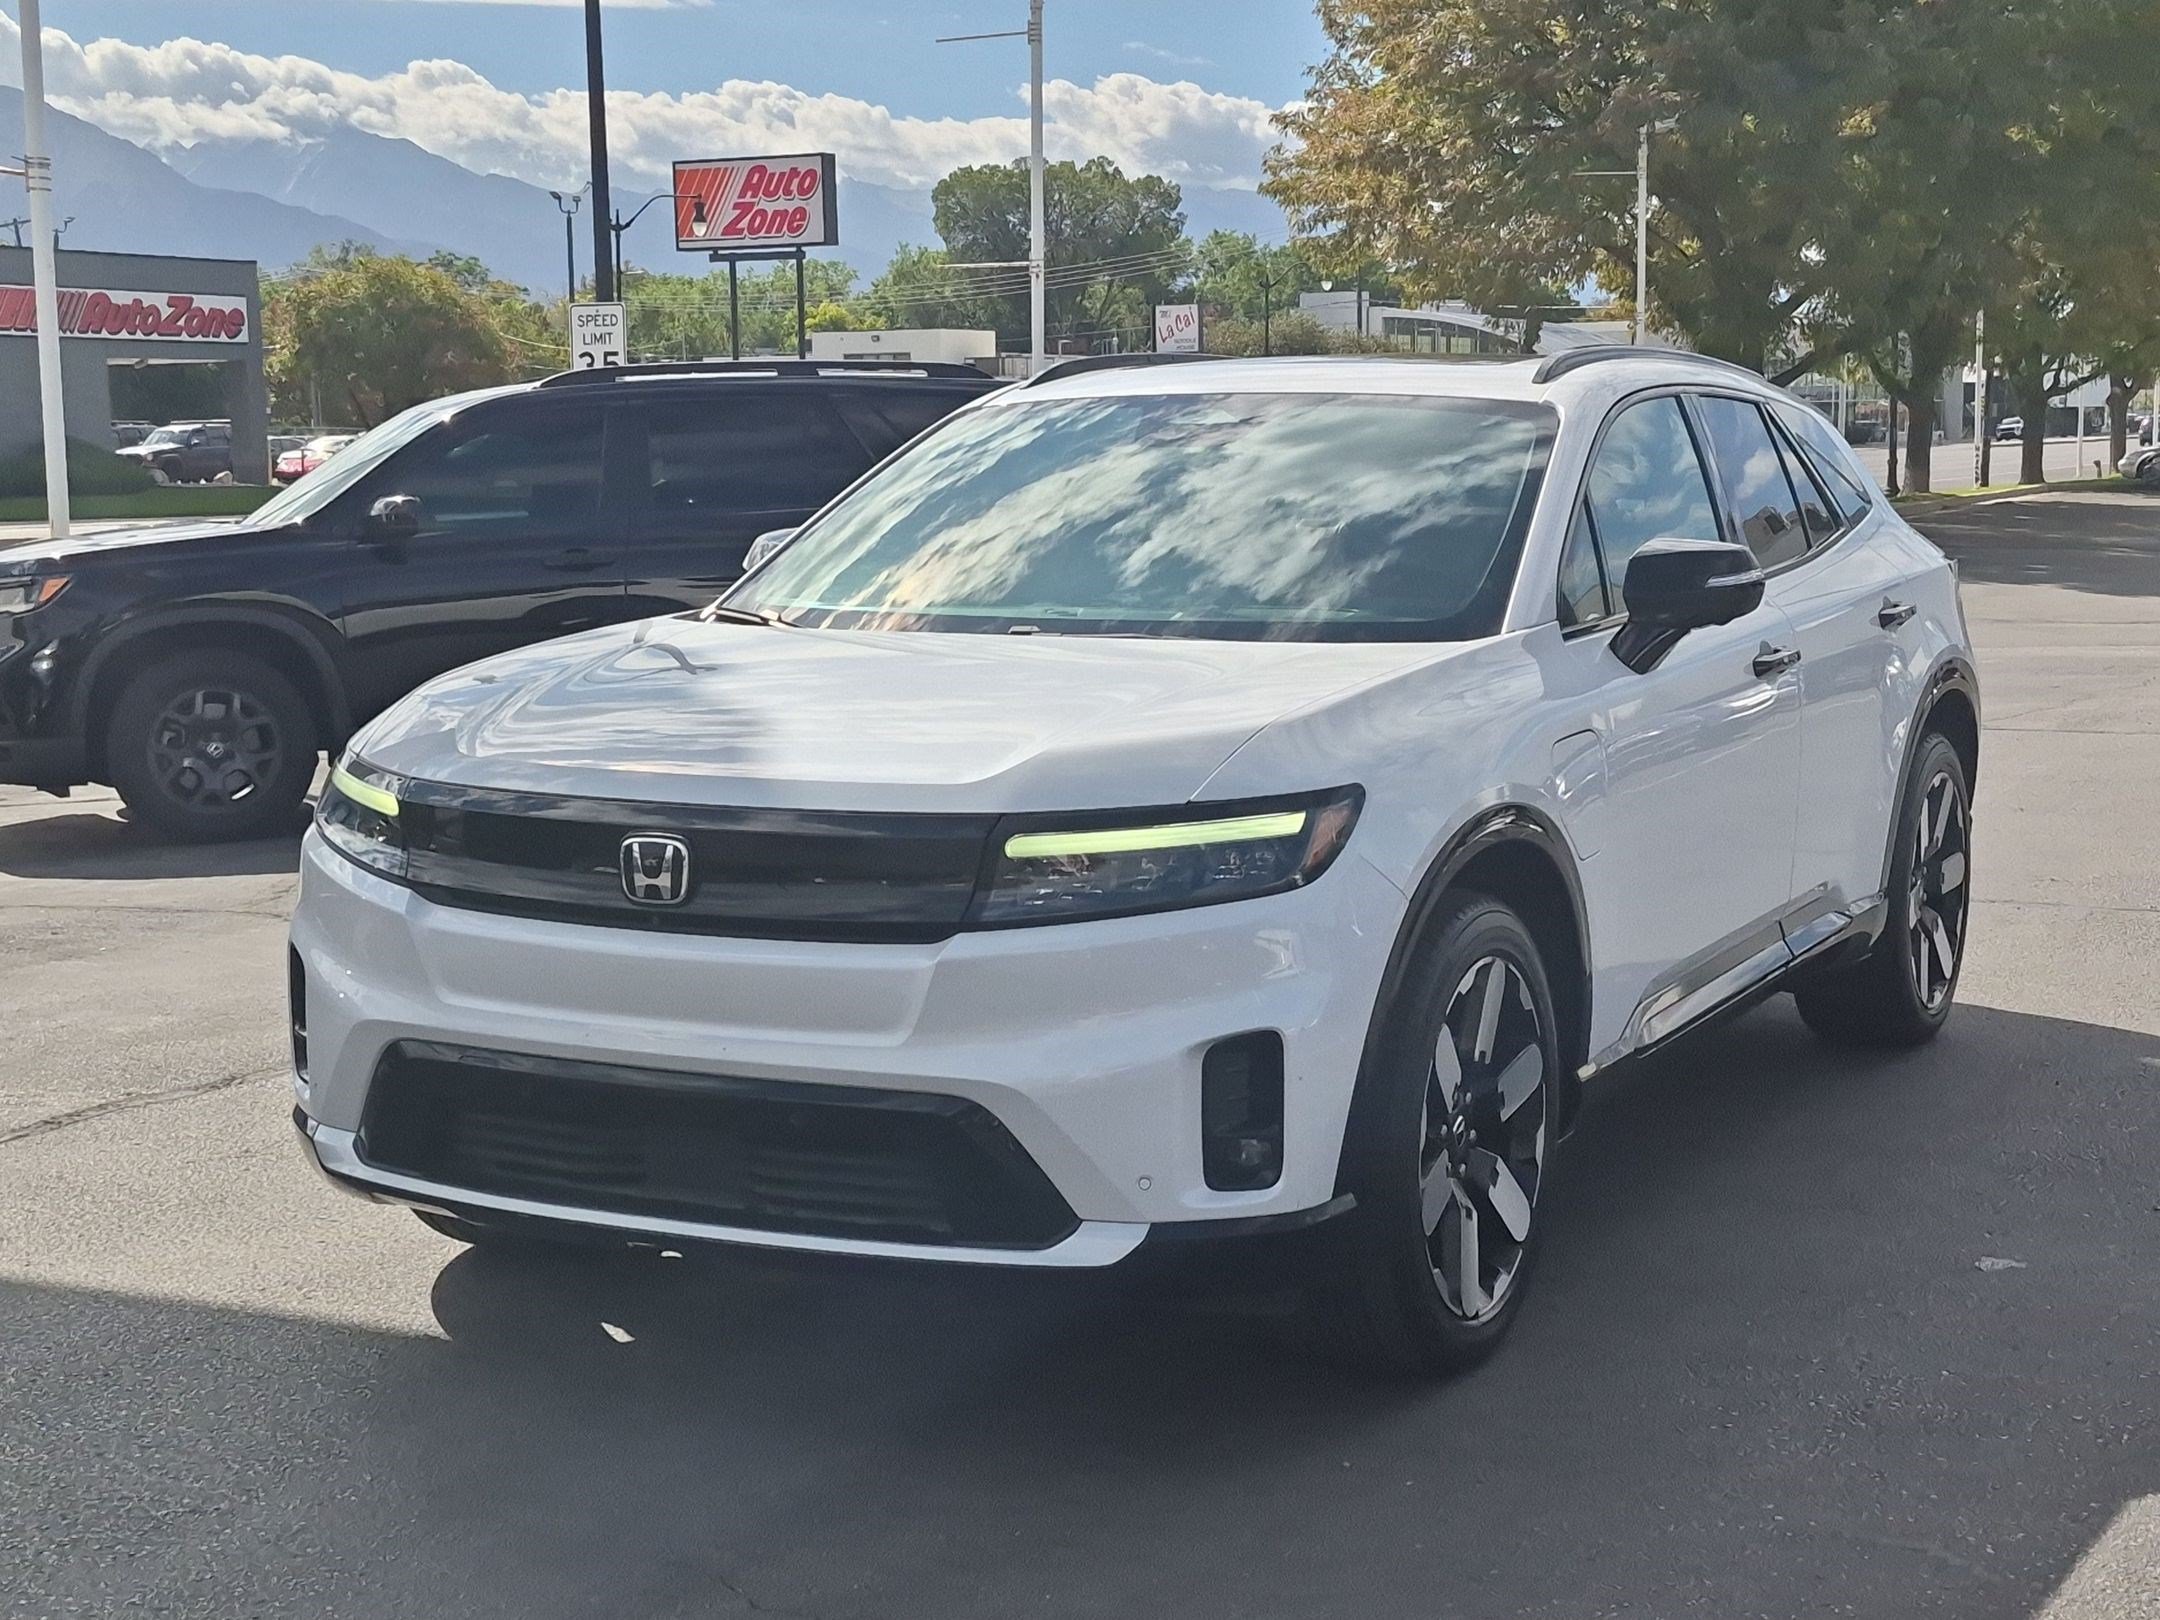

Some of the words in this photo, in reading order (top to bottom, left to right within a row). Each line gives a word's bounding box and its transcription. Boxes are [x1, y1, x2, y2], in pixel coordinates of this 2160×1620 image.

[737, 164, 819, 200] Auto
[721, 201, 809, 237] Zone
[77, 292, 245, 339] AutoZone
[577, 313, 618, 327] SPEED
[582, 332, 613, 346] LIMIT
[1158, 325, 1175, 344] La
